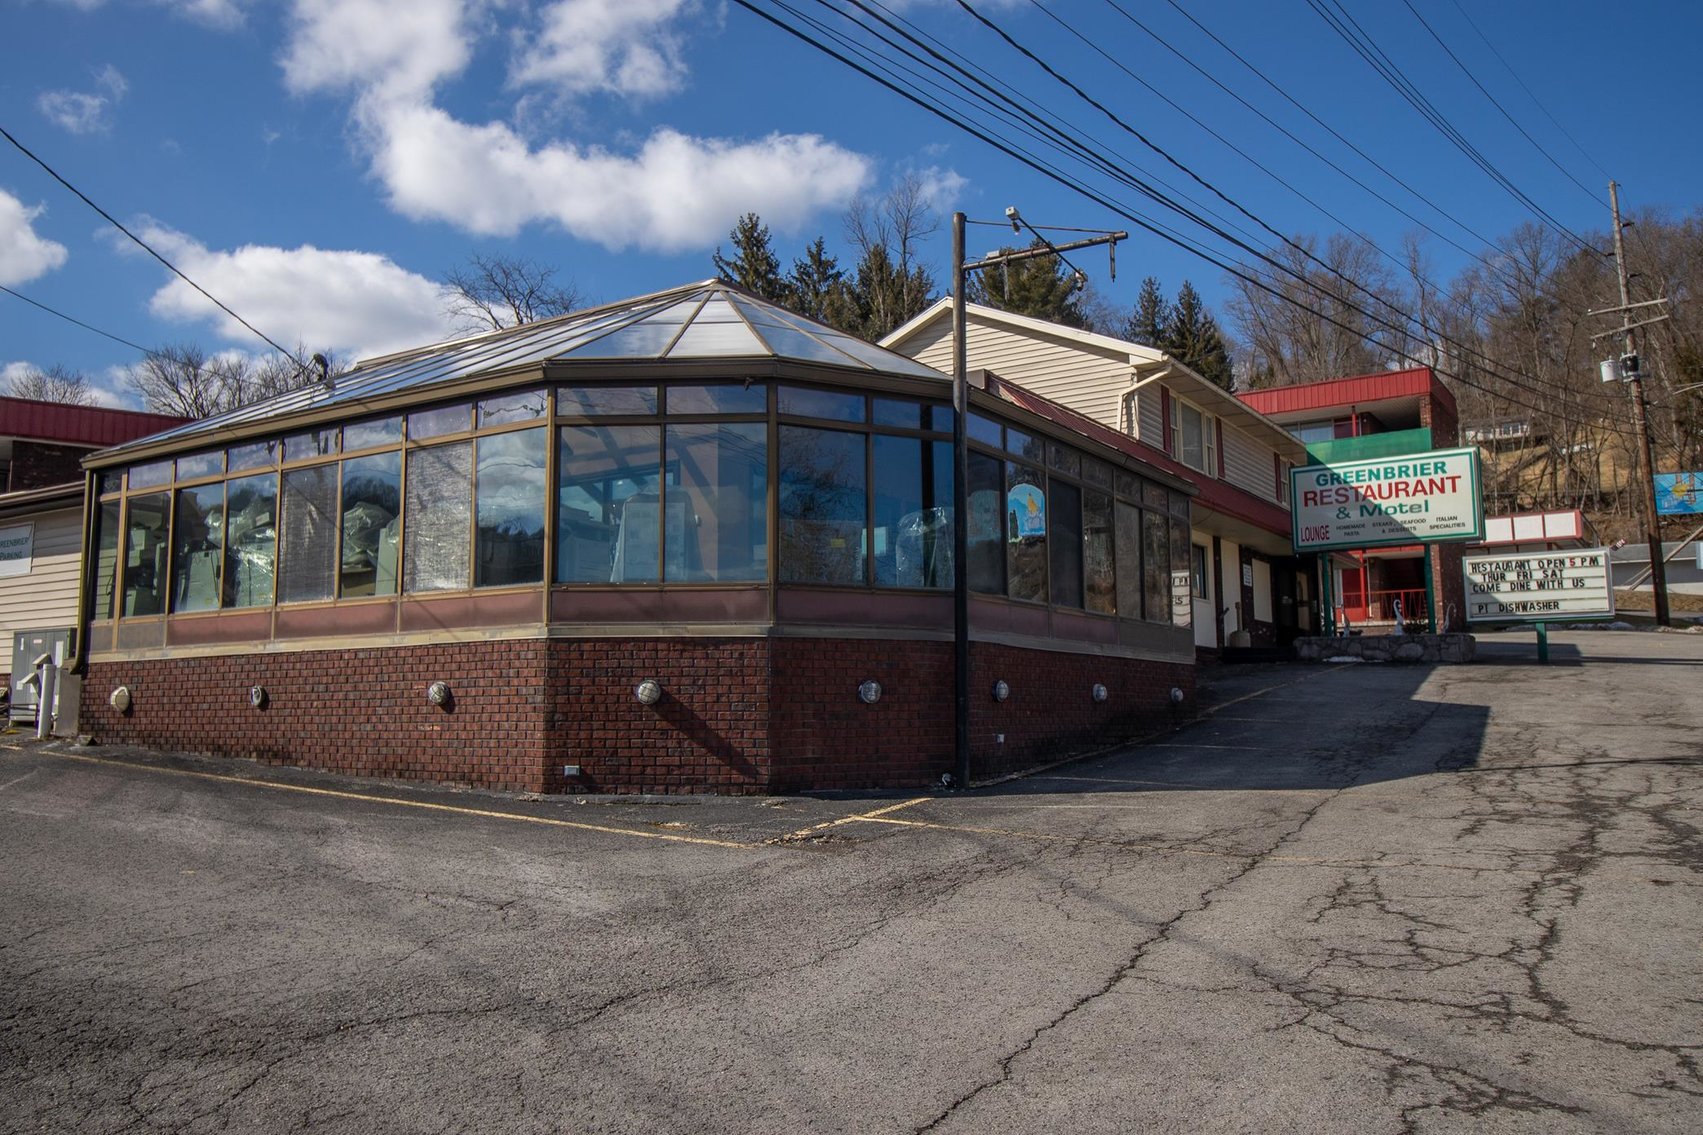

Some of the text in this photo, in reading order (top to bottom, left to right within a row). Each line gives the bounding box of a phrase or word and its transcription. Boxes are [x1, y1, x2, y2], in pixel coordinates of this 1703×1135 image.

[1315, 461, 1448, 487] GREENBRIER
[1303, 475, 1462, 508] RESTAURANT
[1336, 499, 1430, 520] & Motel
[1300, 525, 1330, 543] LOUNGE
[1336, 523, 1366, 531] HOMEMADE
[1429, 522, 1466, 530] SPECIALITIES
[1471, 560, 1532, 574] RESTAURANT
[1537, 558, 1566, 570] OPEN
[1569, 557, 1577, 566] 5
[1481, 568, 1565, 583] THUR FRI SAT
[1472, 578, 1586, 593] COME DINE WITH US
[1498, 601, 1559, 613] DISHWASHER
